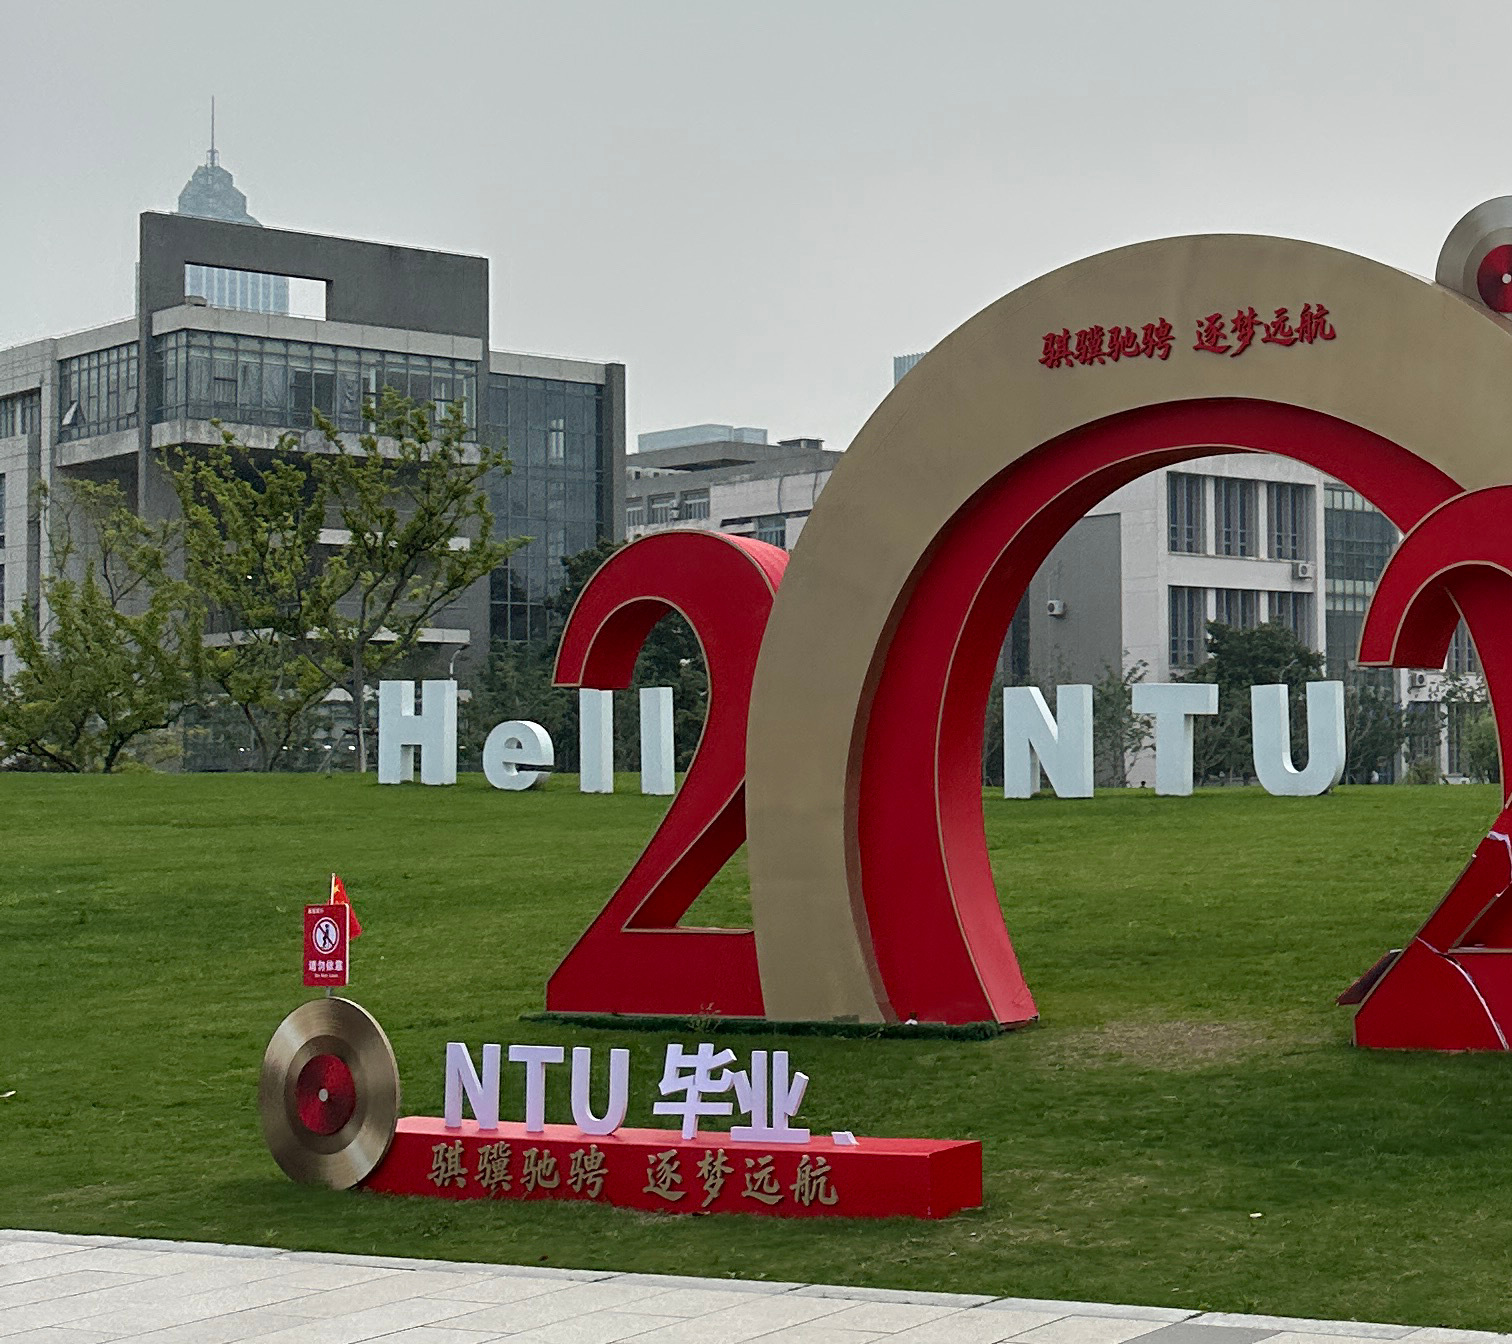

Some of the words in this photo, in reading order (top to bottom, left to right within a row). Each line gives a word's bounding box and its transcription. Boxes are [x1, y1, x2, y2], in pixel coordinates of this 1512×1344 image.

[1038, 317, 1176, 369] 骐骥驰骋
[1193, 303, 1336, 358] 逐梦远航
[1003, 680, 1347, 799] NTU
[444, 1042, 630, 1136] NTU
[653, 1043, 810, 1144] 毕业
[426, 1139, 610, 1199] 骐骥驰骋
[642, 1148, 840, 1207] 逐梦远航
